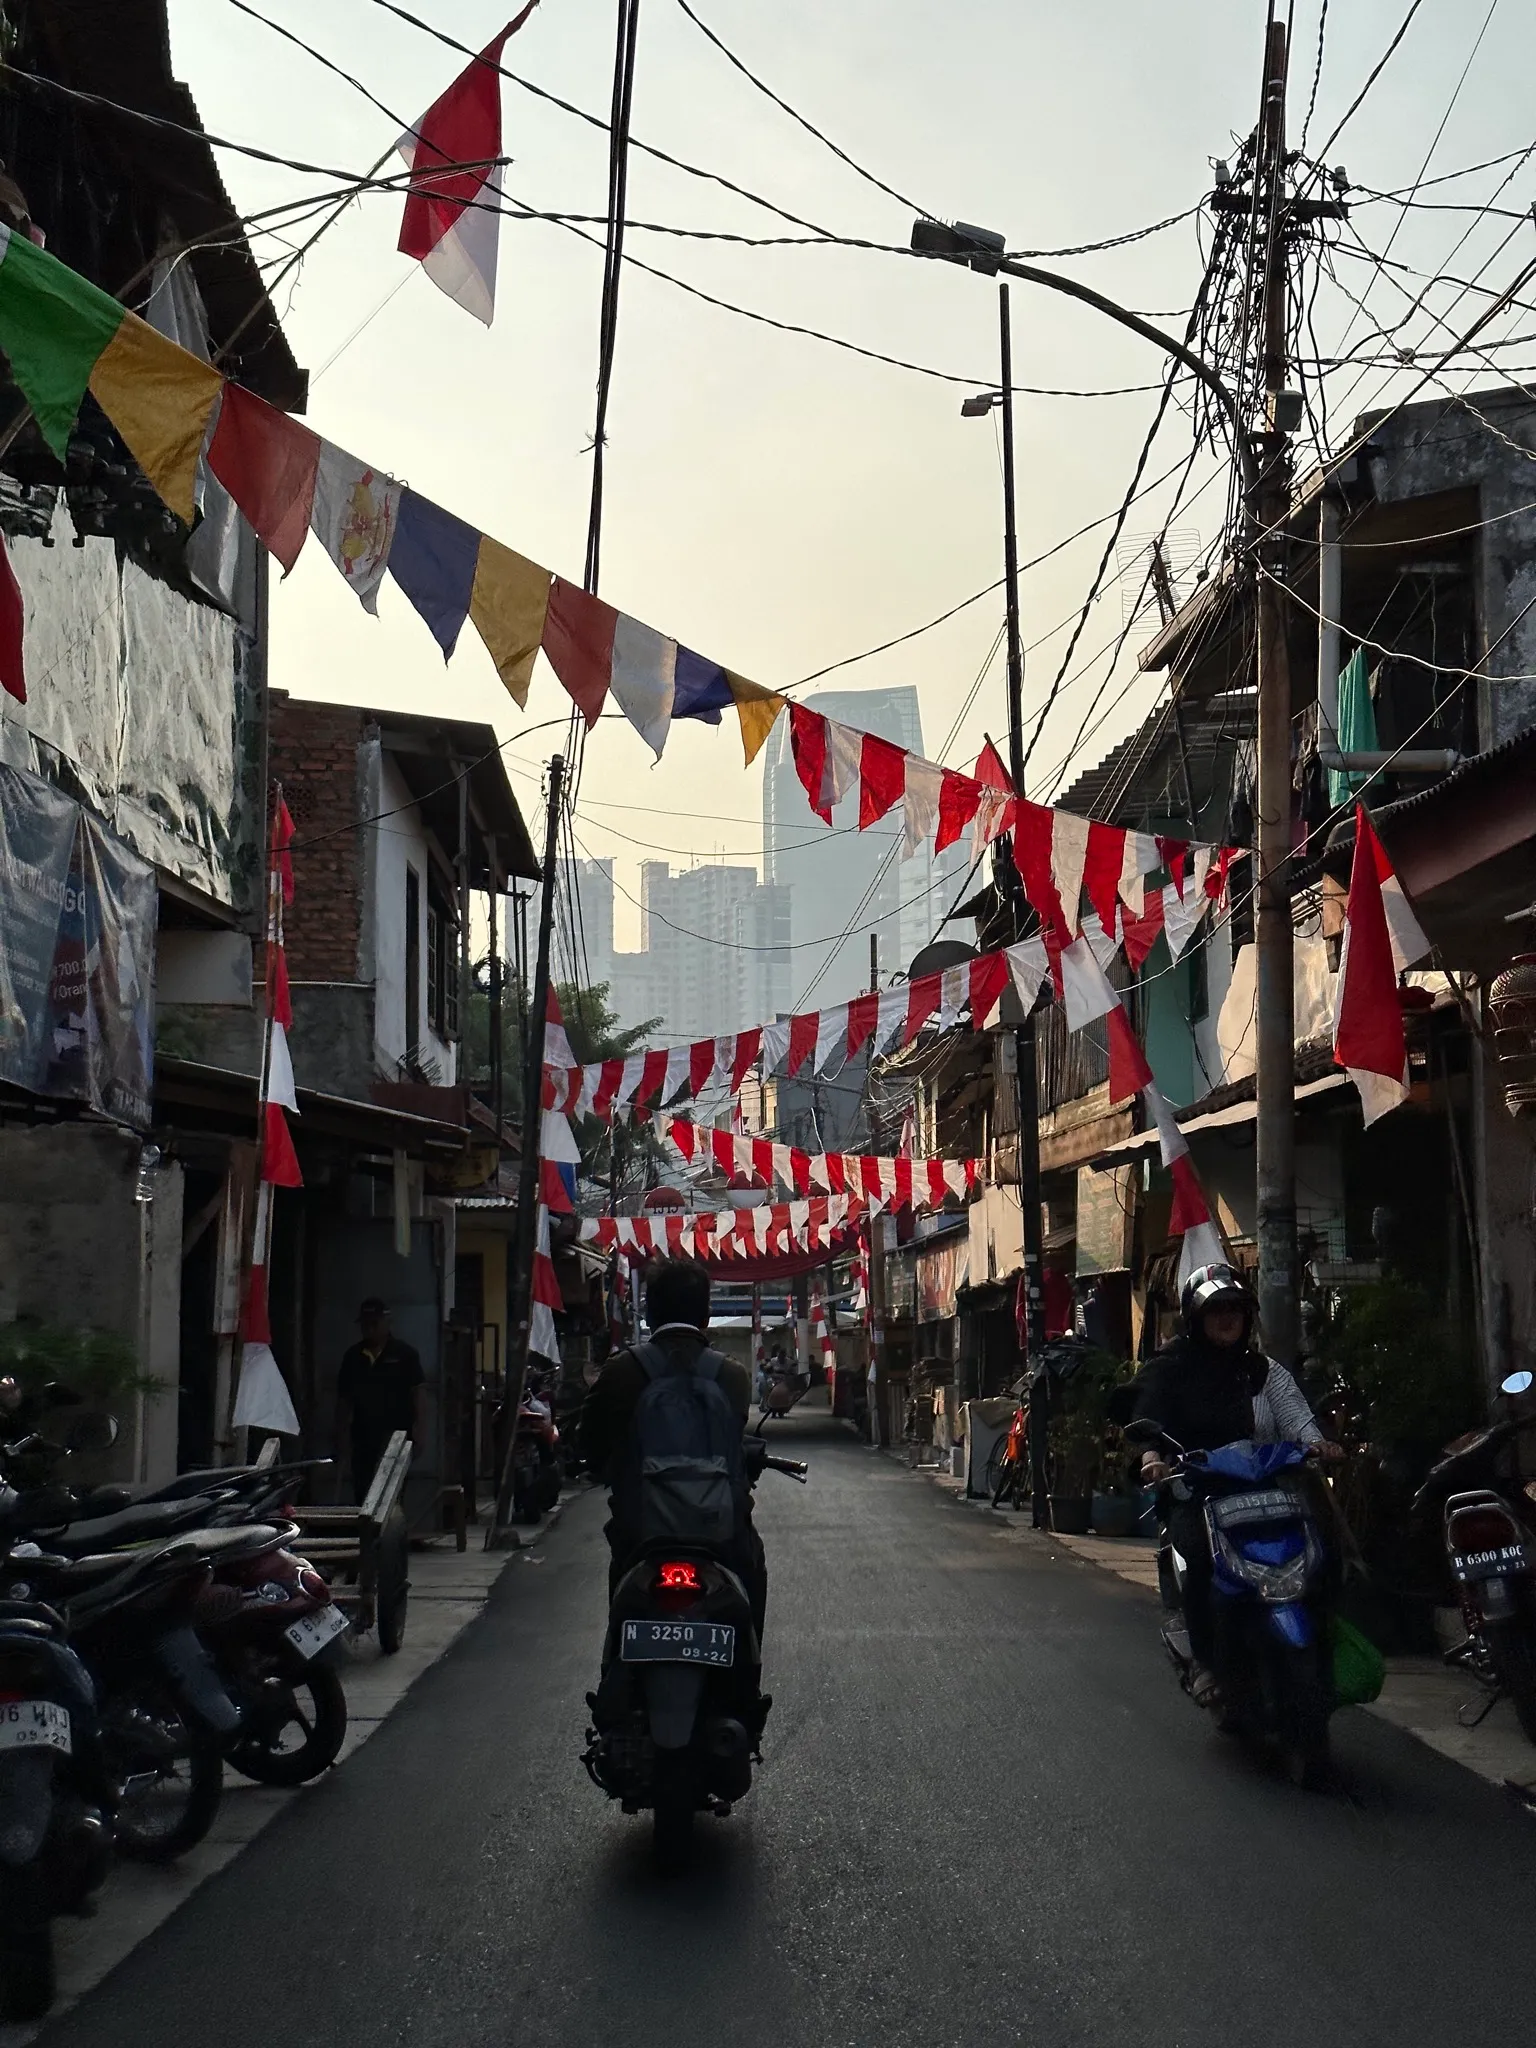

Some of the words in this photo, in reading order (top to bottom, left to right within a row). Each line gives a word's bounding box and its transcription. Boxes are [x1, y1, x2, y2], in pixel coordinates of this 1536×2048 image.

[1454, 1557, 1464, 1568] B
[1467, 1550, 1497, 1565] 6500
[290, 1629, 302, 1643] B
[626, 1624, 637, 1640] N
[651, 1625, 694, 1642] 3250
[710, 1628, 731, 1645] IY
